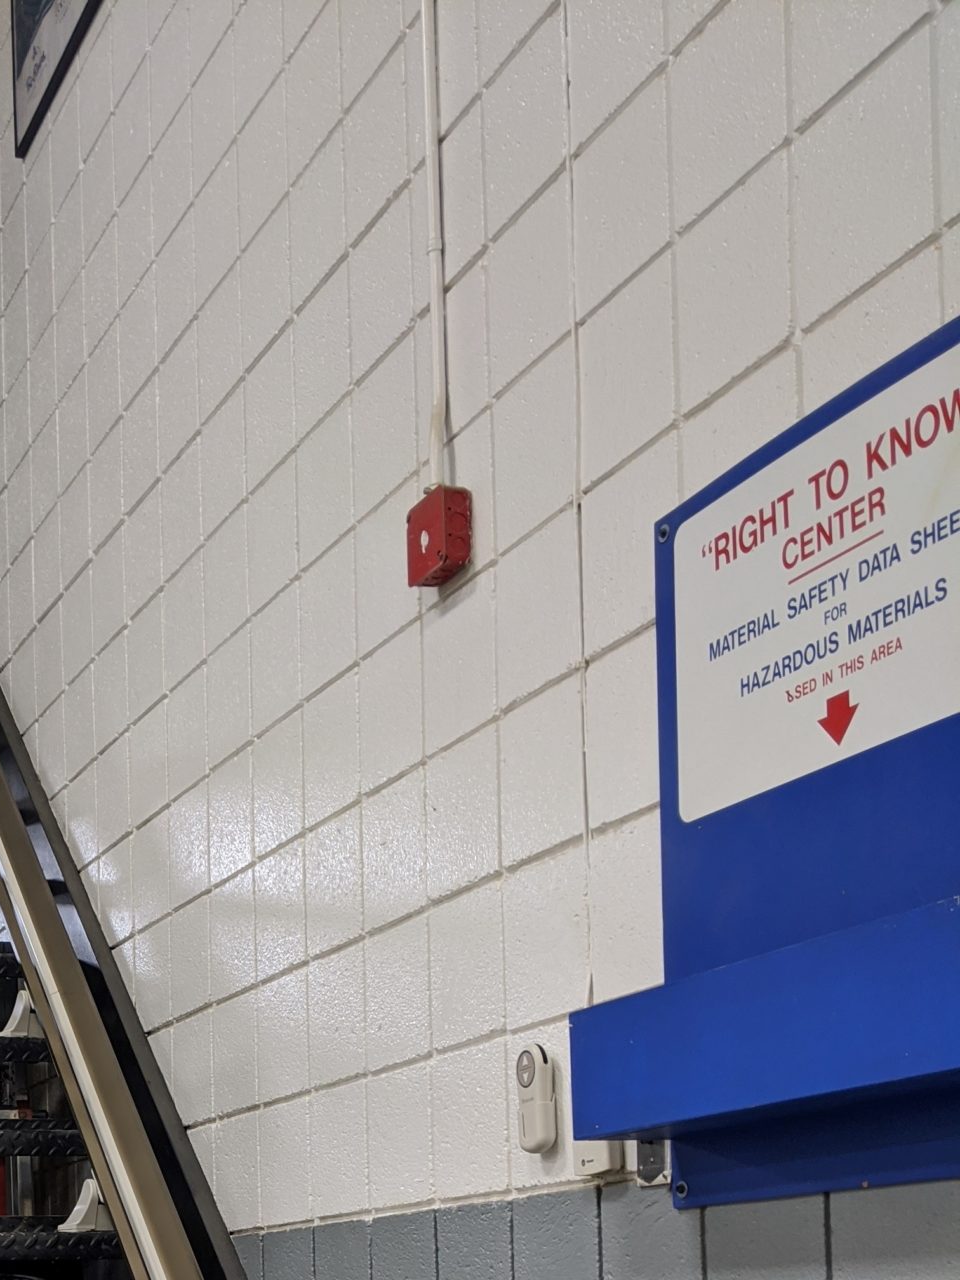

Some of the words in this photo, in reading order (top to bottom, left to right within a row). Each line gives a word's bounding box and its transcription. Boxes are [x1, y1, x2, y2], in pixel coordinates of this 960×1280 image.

[808, 458, 849, 511] TO
[865, 388, 960, 480] KNOW
[781, 486, 886, 570] CENTER
[708, 609, 780, 662] MATERIAL
[787, 568, 850, 620] SAFETY
[858, 543, 901, 583] DATA
[740, 631, 839, 697] HAZARDOUS
[847, 577, 948, 645] MATERIALS
[823, 602, 847, 625] FOR
[822, 669, 833, 687] IN
[838, 654, 864, 678] THIS
[870, 636, 903, 665] AREA
